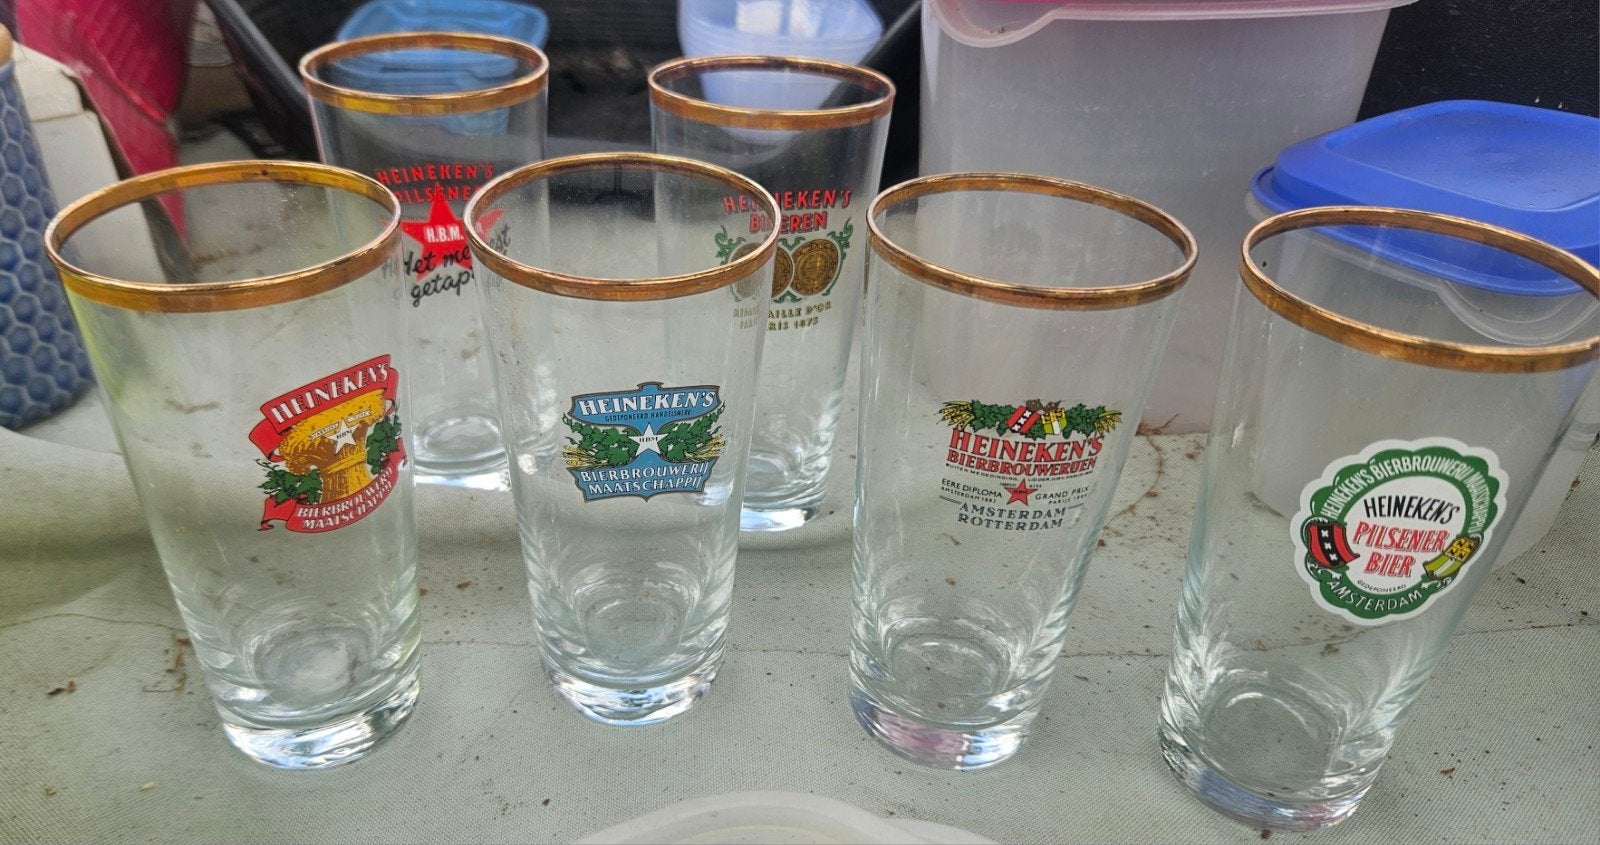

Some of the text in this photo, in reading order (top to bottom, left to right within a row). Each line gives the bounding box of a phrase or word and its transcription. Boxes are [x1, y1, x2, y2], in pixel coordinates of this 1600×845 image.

[376, 163, 494, 185] HEINEKEN'S
[424, 223, 464, 243] H.B.M.
[411, 270, 475, 308] getap
[270, 362, 389, 424] HEINEKEN'S
[578, 391, 716, 416] HEINEKEN'S
[949, 427, 1106, 463] HEINEKEN'S
[580, 461, 710, 482] BIERBROUWERIJ
[588, 476, 702, 495] MAATSCHAPPIJ
[941, 478, 962, 490] EERE
[962, 484, 1003, 499] DIPLOMA
[1035, 490, 1069, 500] GRAND
[1320, 469, 1375, 520] HEINEKEN'S
[1369, 455, 1475, 482] BIERBROUWERIJ
[957, 513, 1063, 531] ROTTERDAM
[959, 502, 1067, 519] AMSTERDAM
[1363, 494, 1461, 525] HEINEKEN'S
[1352, 520, 1451, 553] PILSENER
[1363, 551, 1416, 578] BIER
[1327, 580, 1423, 611] AMSTERDAM
